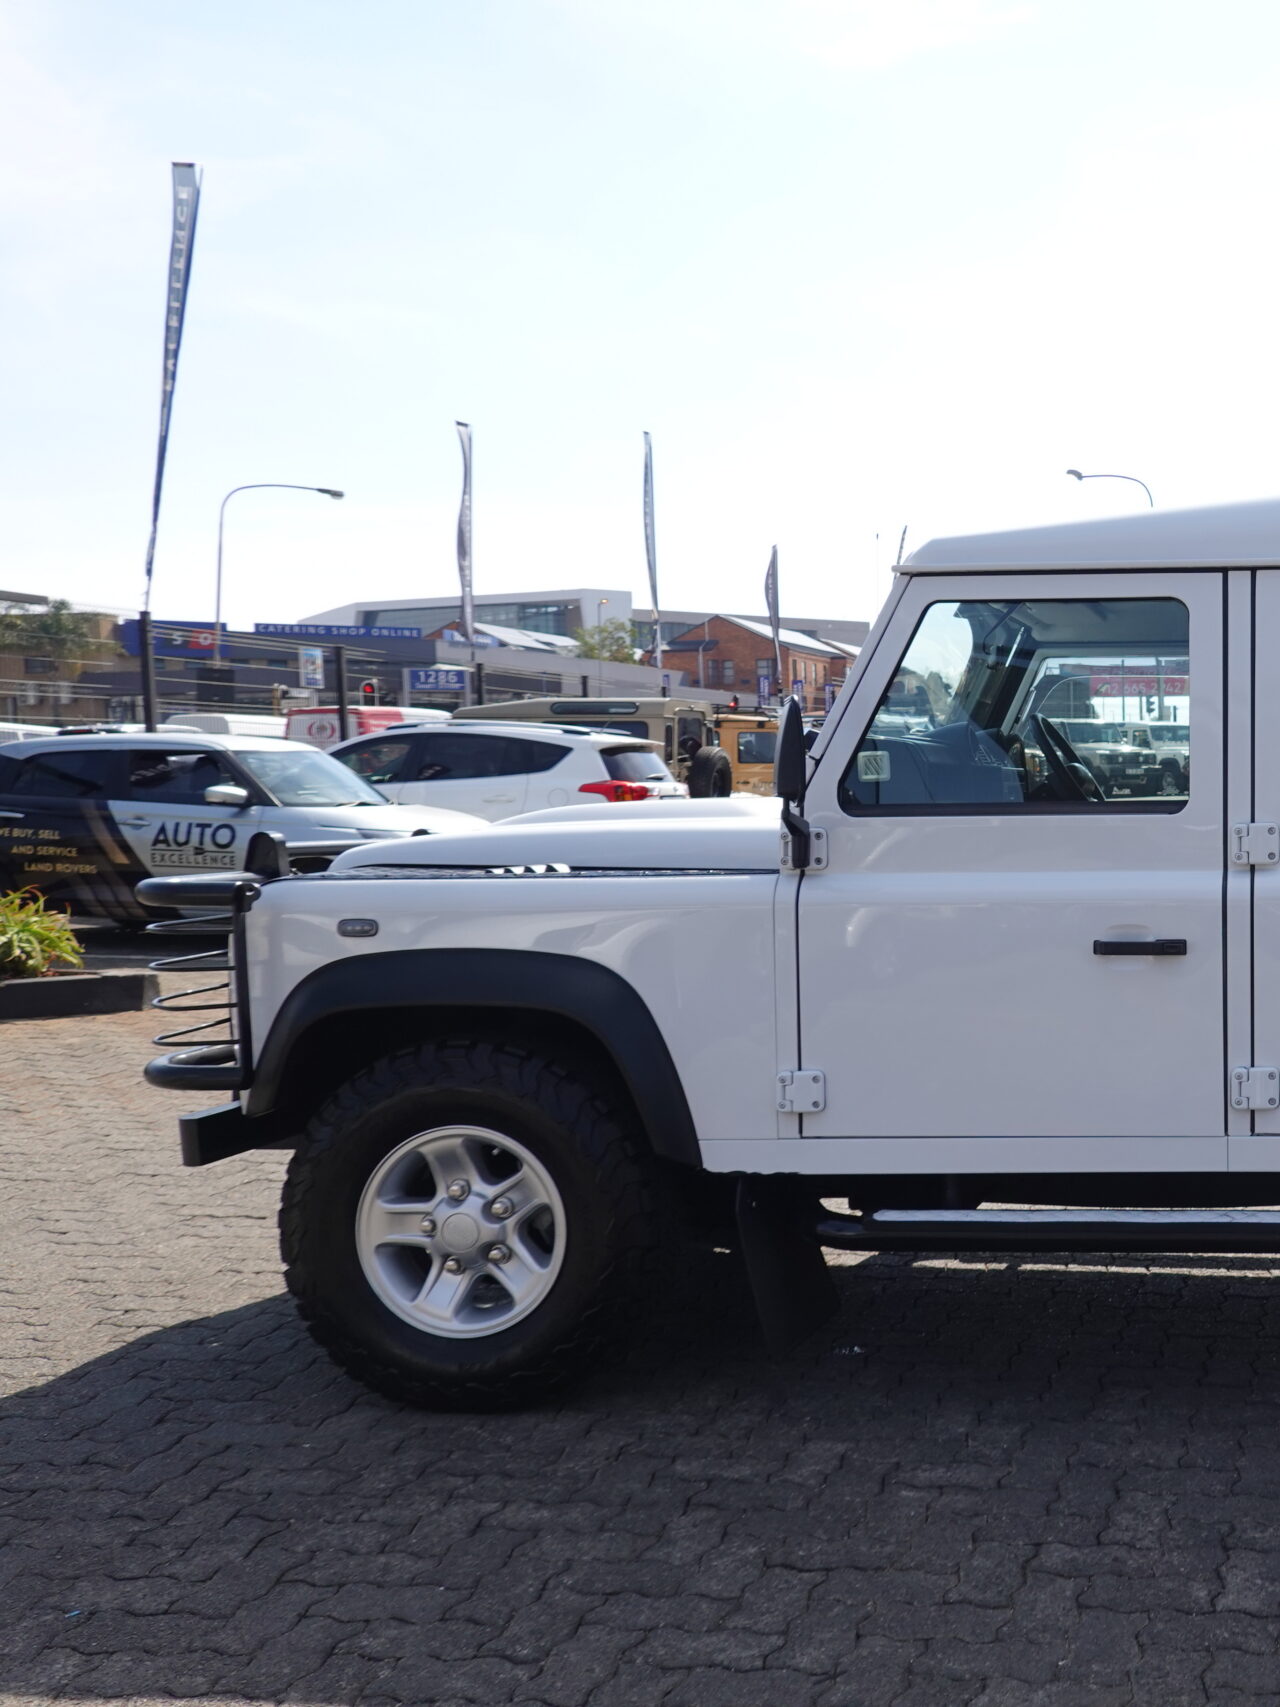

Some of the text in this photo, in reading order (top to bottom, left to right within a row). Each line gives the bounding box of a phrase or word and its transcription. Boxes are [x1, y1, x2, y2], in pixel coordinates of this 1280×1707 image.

[258, 624, 420, 638] CATERING SHOP ONLINE
[418, 671, 458, 683] 1286
[1151, 682, 1182, 694] 242
[12, 828, 35, 839] BUY,
[37, 829, 61, 840] SELL
[151, 822, 236, 849] AUTO
[11, 844, 79, 857] AND SERVICE
[151, 852, 236, 866] EXCELLENCE
[24, 862, 98, 875] LAND ROVERS
